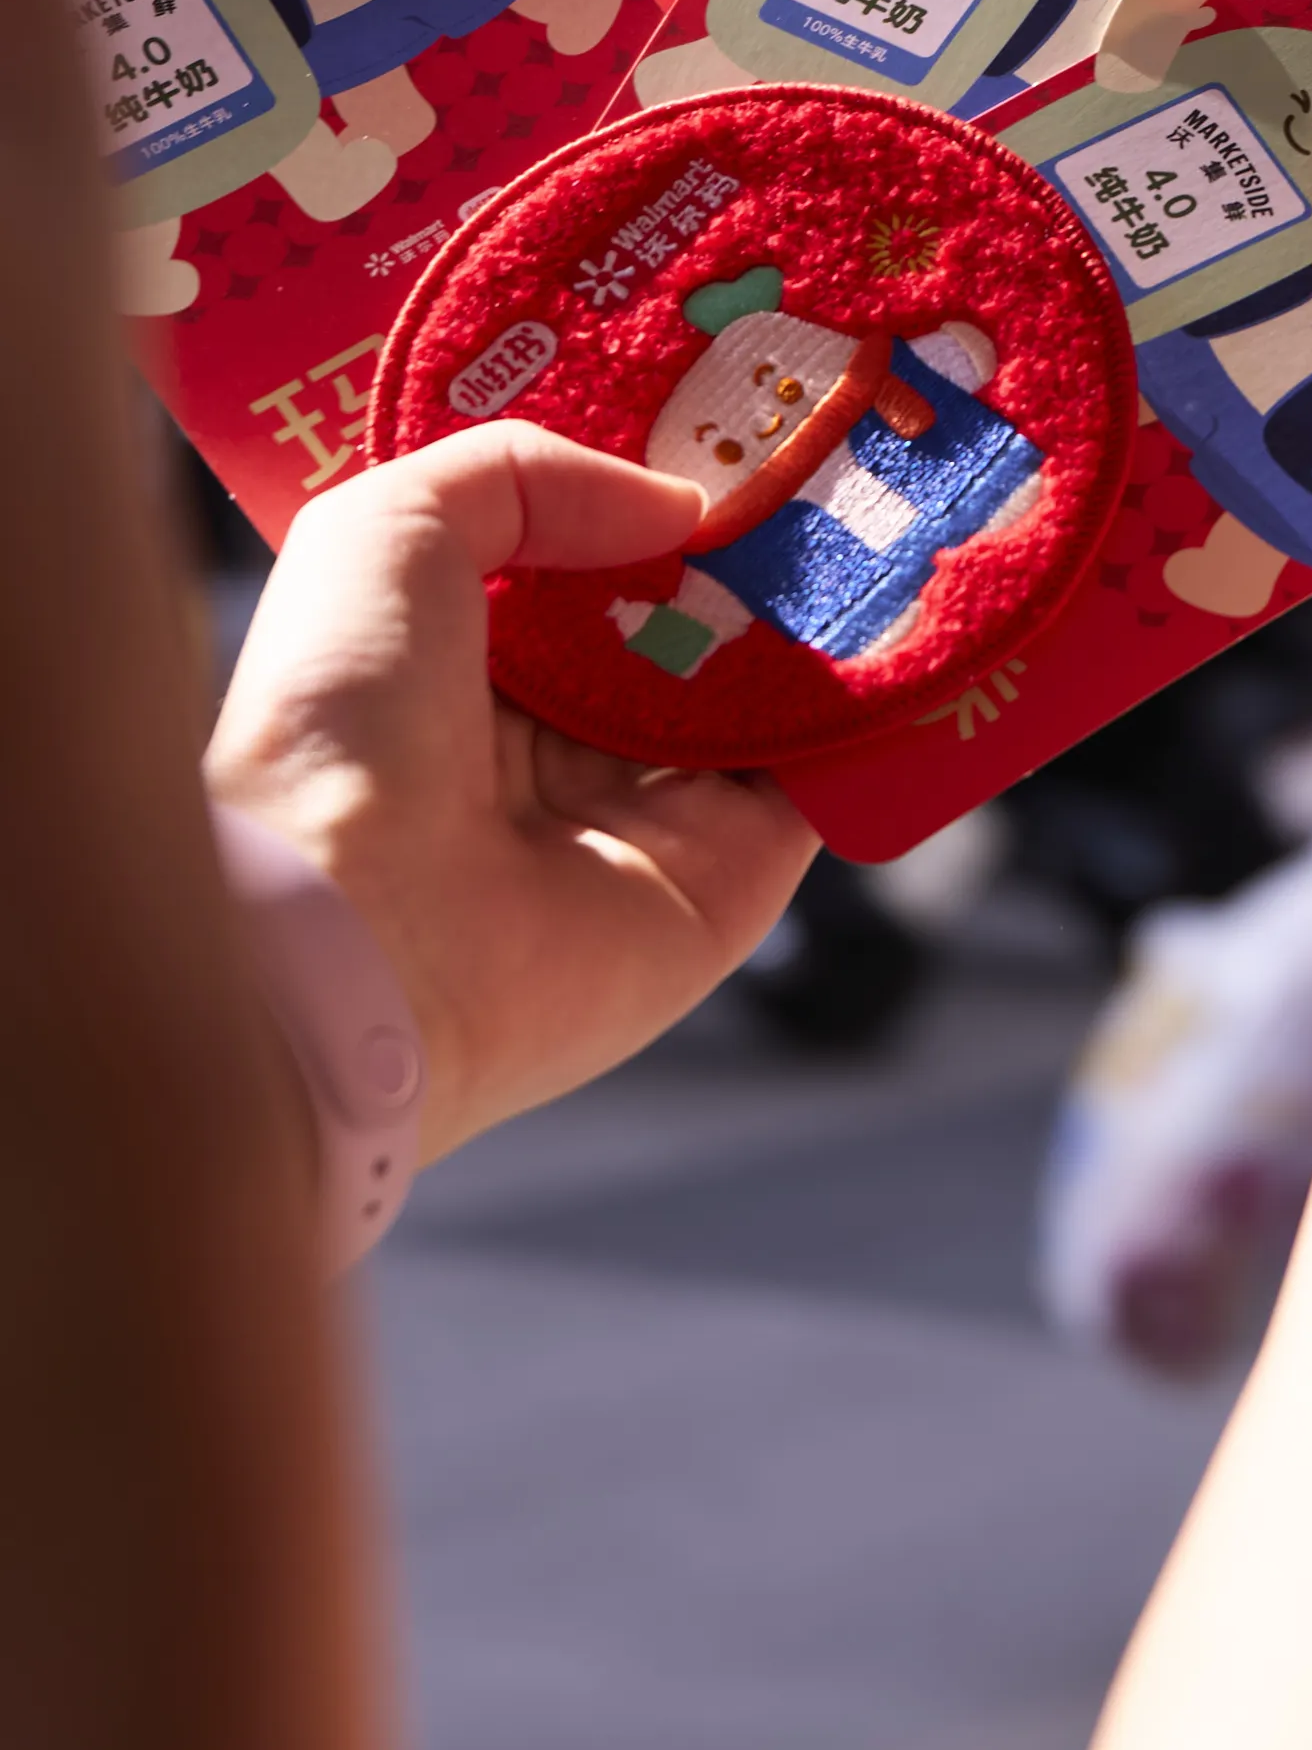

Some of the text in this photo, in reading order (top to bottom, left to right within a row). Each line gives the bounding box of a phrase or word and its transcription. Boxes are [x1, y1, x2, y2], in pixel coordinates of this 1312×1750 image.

[111, 36, 172, 82] 4.0
[802, 16, 889, 63] 100%生牛乳
[104, 58, 219, 133] 纯牛奶
[140, 107, 233, 159] 100%生牛乳
[610, 157, 713, 250] Walmart
[1145, 170, 1197, 219] 4.0
[1166, 125, 1248, 221] 沃集鲜
[1183, 108, 1274, 219] MARKETSIDE
[635, 165, 740, 268] 沃尔玛
[1084, 166, 1170, 260] 纯牛奶
[458, 326, 547, 408] 小红书
